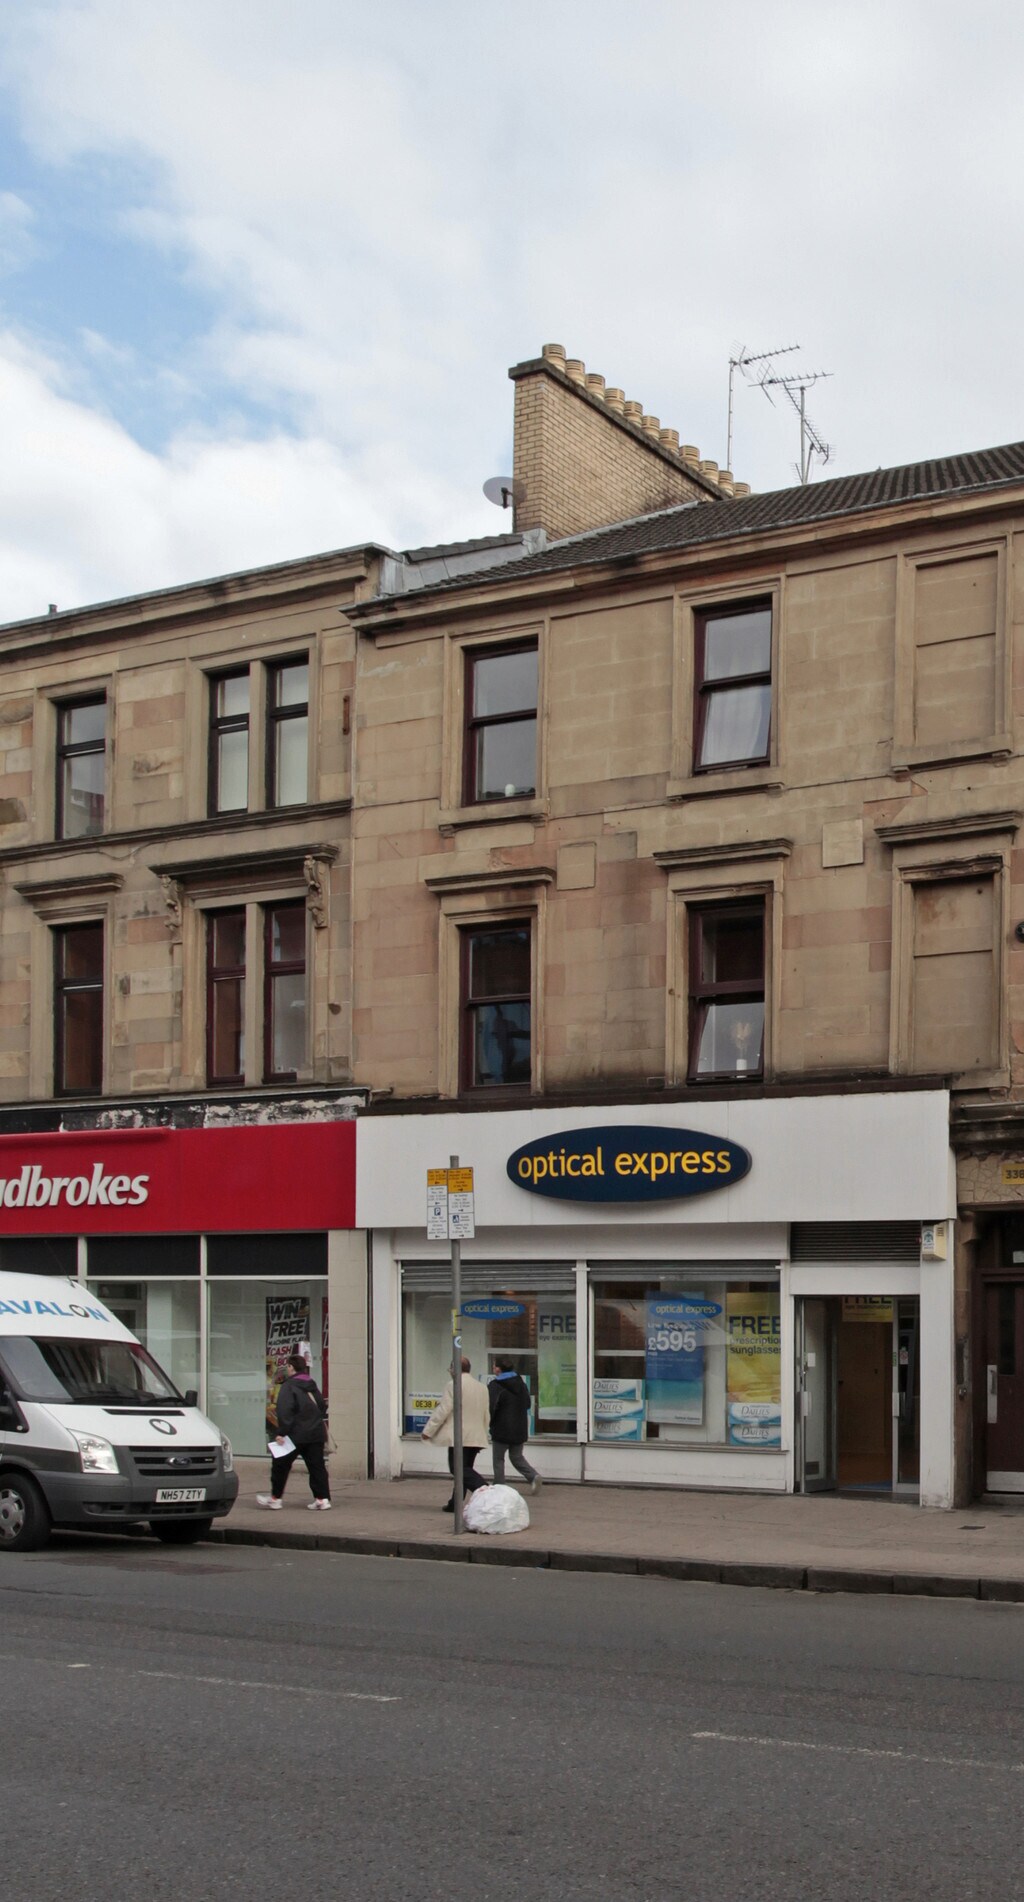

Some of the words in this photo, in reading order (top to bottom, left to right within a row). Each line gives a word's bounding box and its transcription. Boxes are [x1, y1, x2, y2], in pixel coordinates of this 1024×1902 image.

[517, 1145, 605, 1185] optical
[614, 1150, 732, 1182] express
[268, 1300, 302, 1321] WIN
[464, 1303, 490, 1313] optical
[491, 1304, 520, 1314] express
[655, 1303, 683, 1315] optical
[685, 1305, 717, 1315] express
[270, 1317, 307, 1339] FREE
[647, 1330, 697, 1353] £595
[271, 1345, 292, 1356] CASH
[160, 1490, 185, 1500] NH57
[185, 1489, 203, 1500] ZTY
